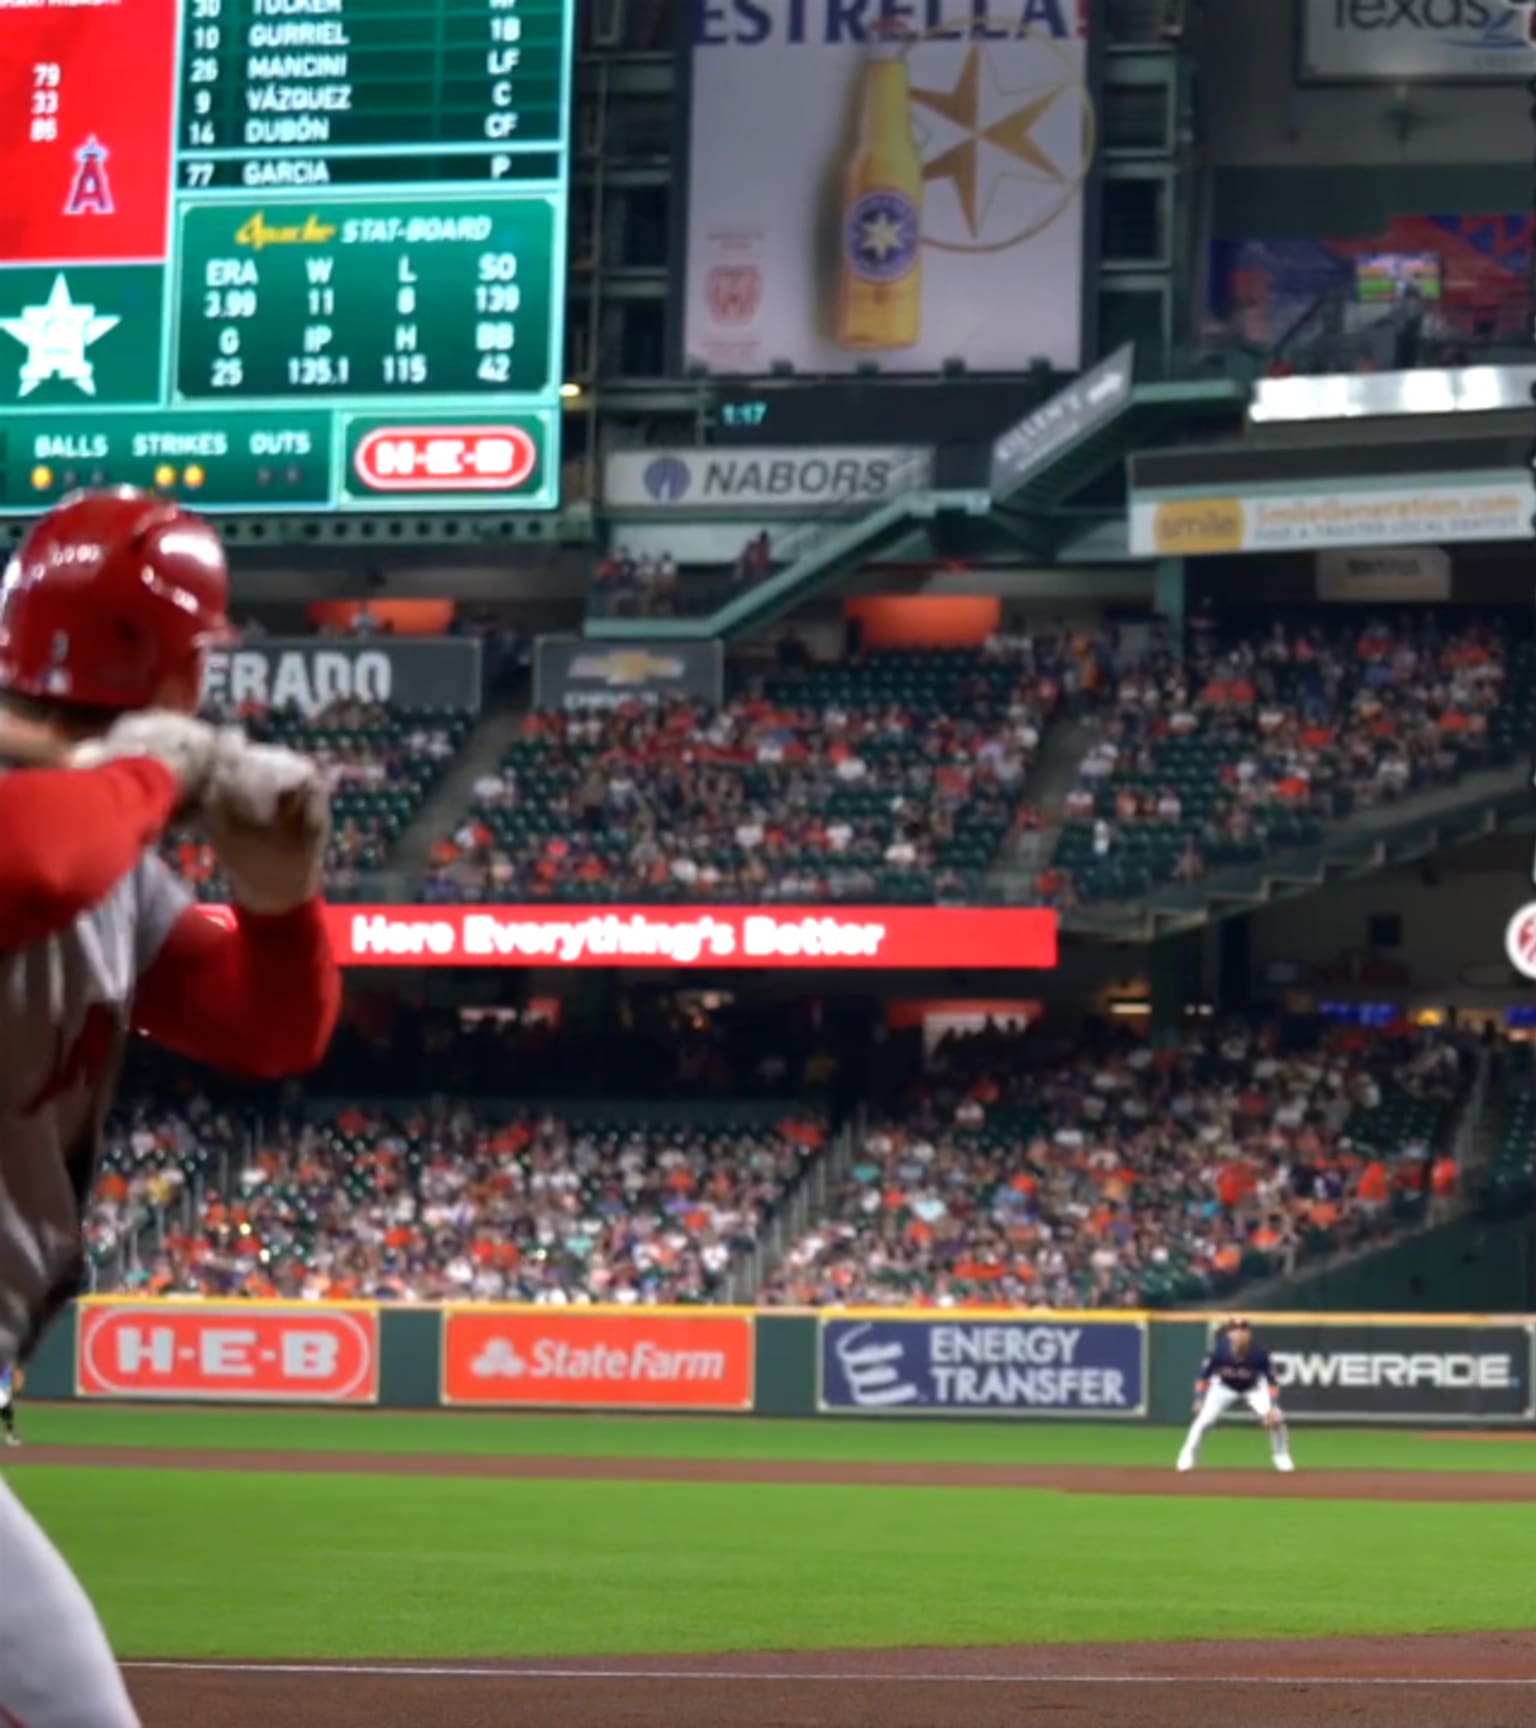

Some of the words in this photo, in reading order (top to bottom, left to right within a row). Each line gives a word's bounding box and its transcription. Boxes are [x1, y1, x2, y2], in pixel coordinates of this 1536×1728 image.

[193, 25, 220, 49] 10
[248, 21, 350, 47] GURRIEL
[490, 15, 521, 42] 1B
[33, 62, 61, 88] 79
[247, 53, 347, 79] MANCINI
[487, 48, 520, 75] LF
[195, 90, 211, 115] 9
[246, 82, 352, 112] VÁZQUEZ
[492, 80, 512, 107] C
[245, 114, 329, 144] DUBÓN
[484, 112, 518, 138] CF
[186, 162, 214, 187] 77
[243, 160, 329, 186] GARCIA
[490, 154, 511, 180] P
[341, 216, 492, 243] STAT-BOARD
[206, 259, 258, 286] ERA
[305, 257, 333, 284] W
[398, 254, 417, 283] L
[478, 253, 517, 281] SO
[205, 289, 257, 318] 3.99
[308, 288, 334, 315] 11
[303, 325, 333, 353] IP
[395, 324, 418, 351] H
[210, 357, 243, 387] 25
[288, 356, 349, 385] 135.1
[383, 354, 427, 383] 115
[477, 353, 511, 382] 42
[35, 435, 109, 457] BALLS
[132, 432, 228, 456] STRIKES
[250, 431, 311, 455] OUTS
[703, 458, 892, 495] NABORS
[1159, 511, 1237, 540] smile
[352, 914, 454, 953] Here
[463, 915, 734, 961] Everything's
[743, 916, 885, 955] Better
[929, 1328, 1082, 1364] ENERGY
[930, 1366, 1128, 1406] TRANSFER
